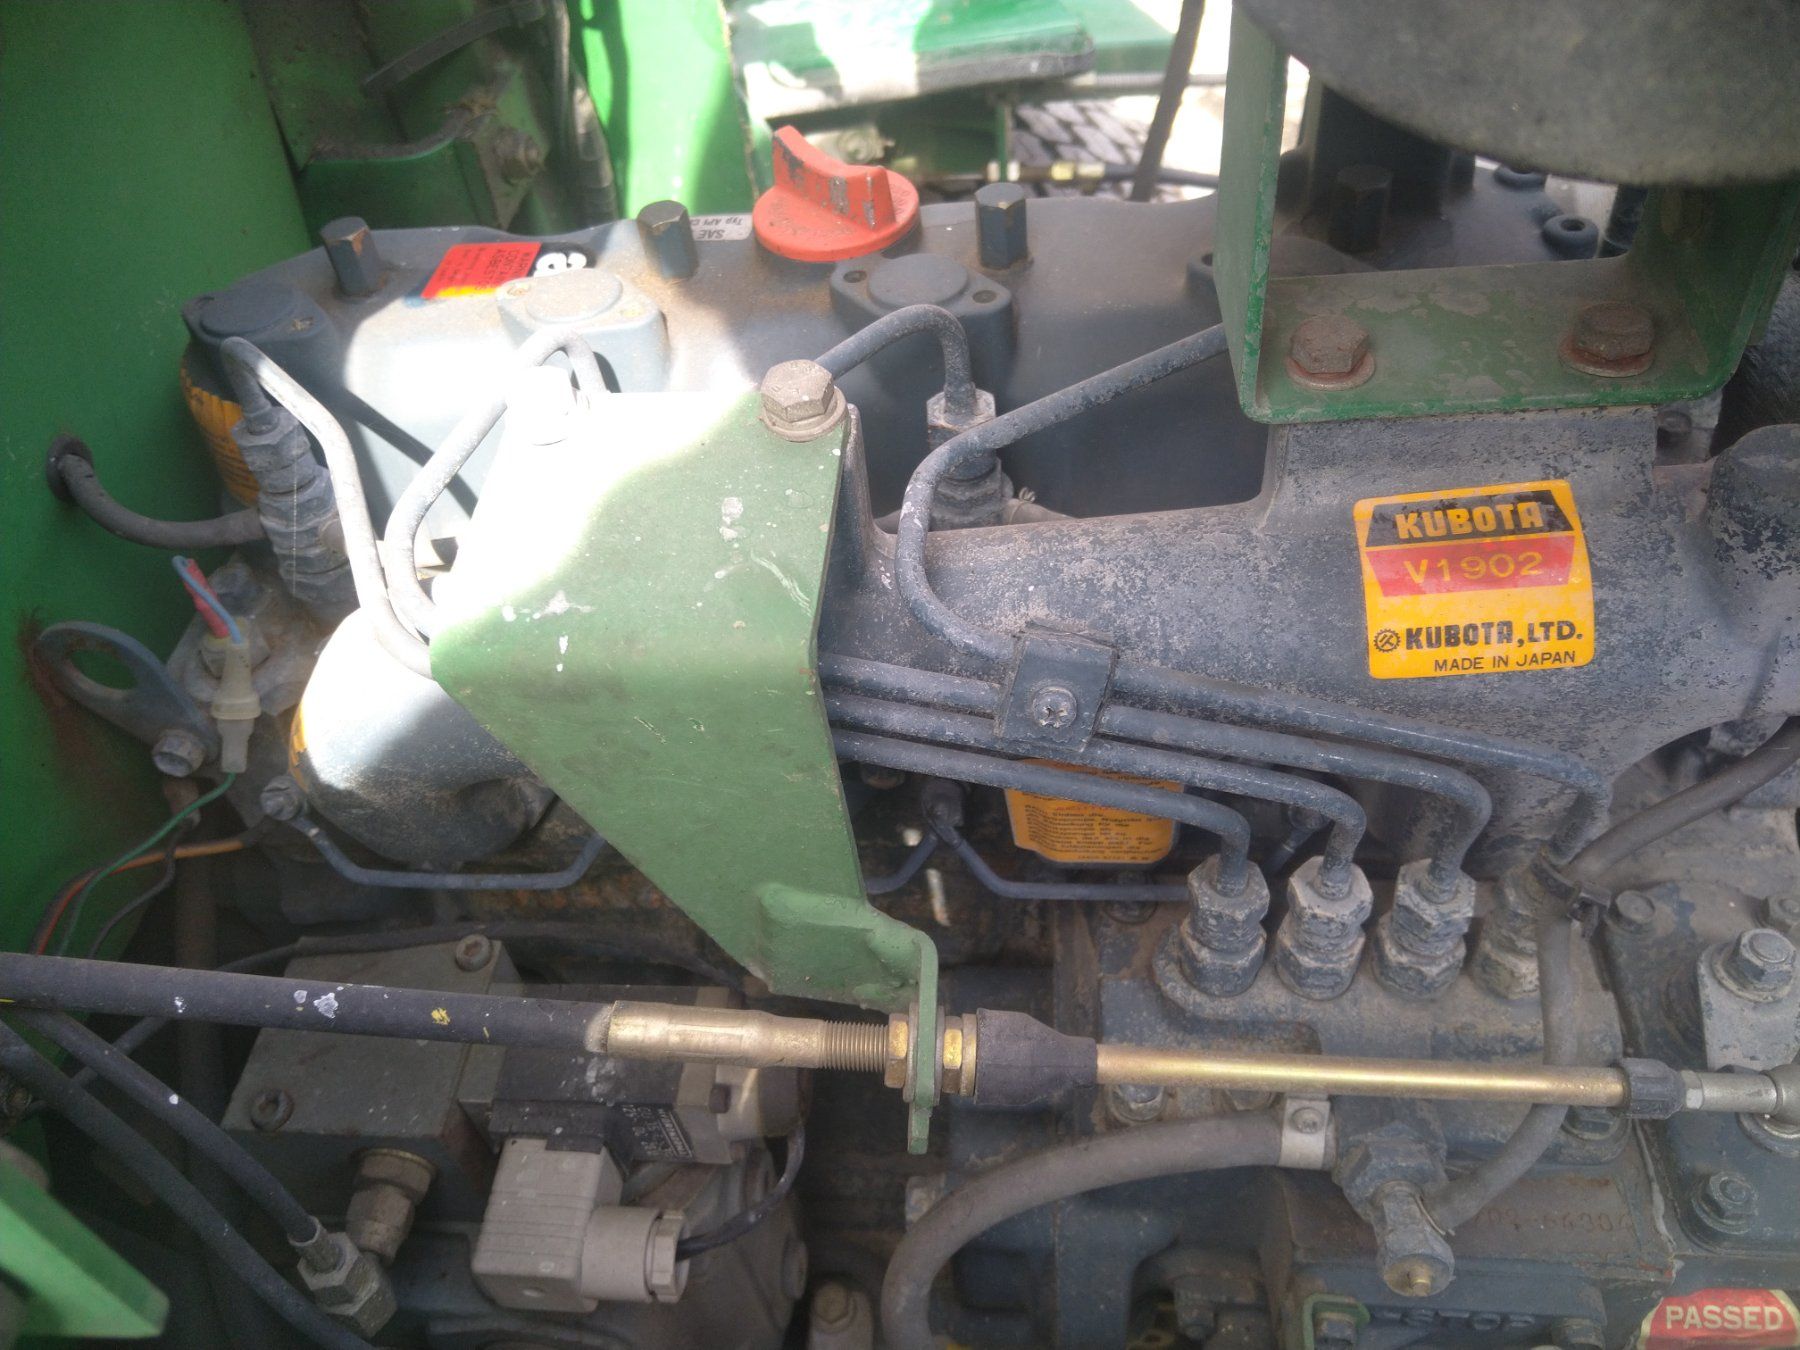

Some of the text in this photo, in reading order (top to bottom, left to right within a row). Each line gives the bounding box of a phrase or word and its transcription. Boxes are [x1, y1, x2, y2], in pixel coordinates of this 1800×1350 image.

[697, 230, 724, 239] SAE
[1395, 502, 1544, 539] KUBOTA
[1403, 551, 1543, 584] V1902
[1405, 620, 1583, 650] KUBOTA,LTD.
[1434, 651, 1576, 672] MADE IN JAPAN
[1666, 1305, 1783, 1330] PASSED
